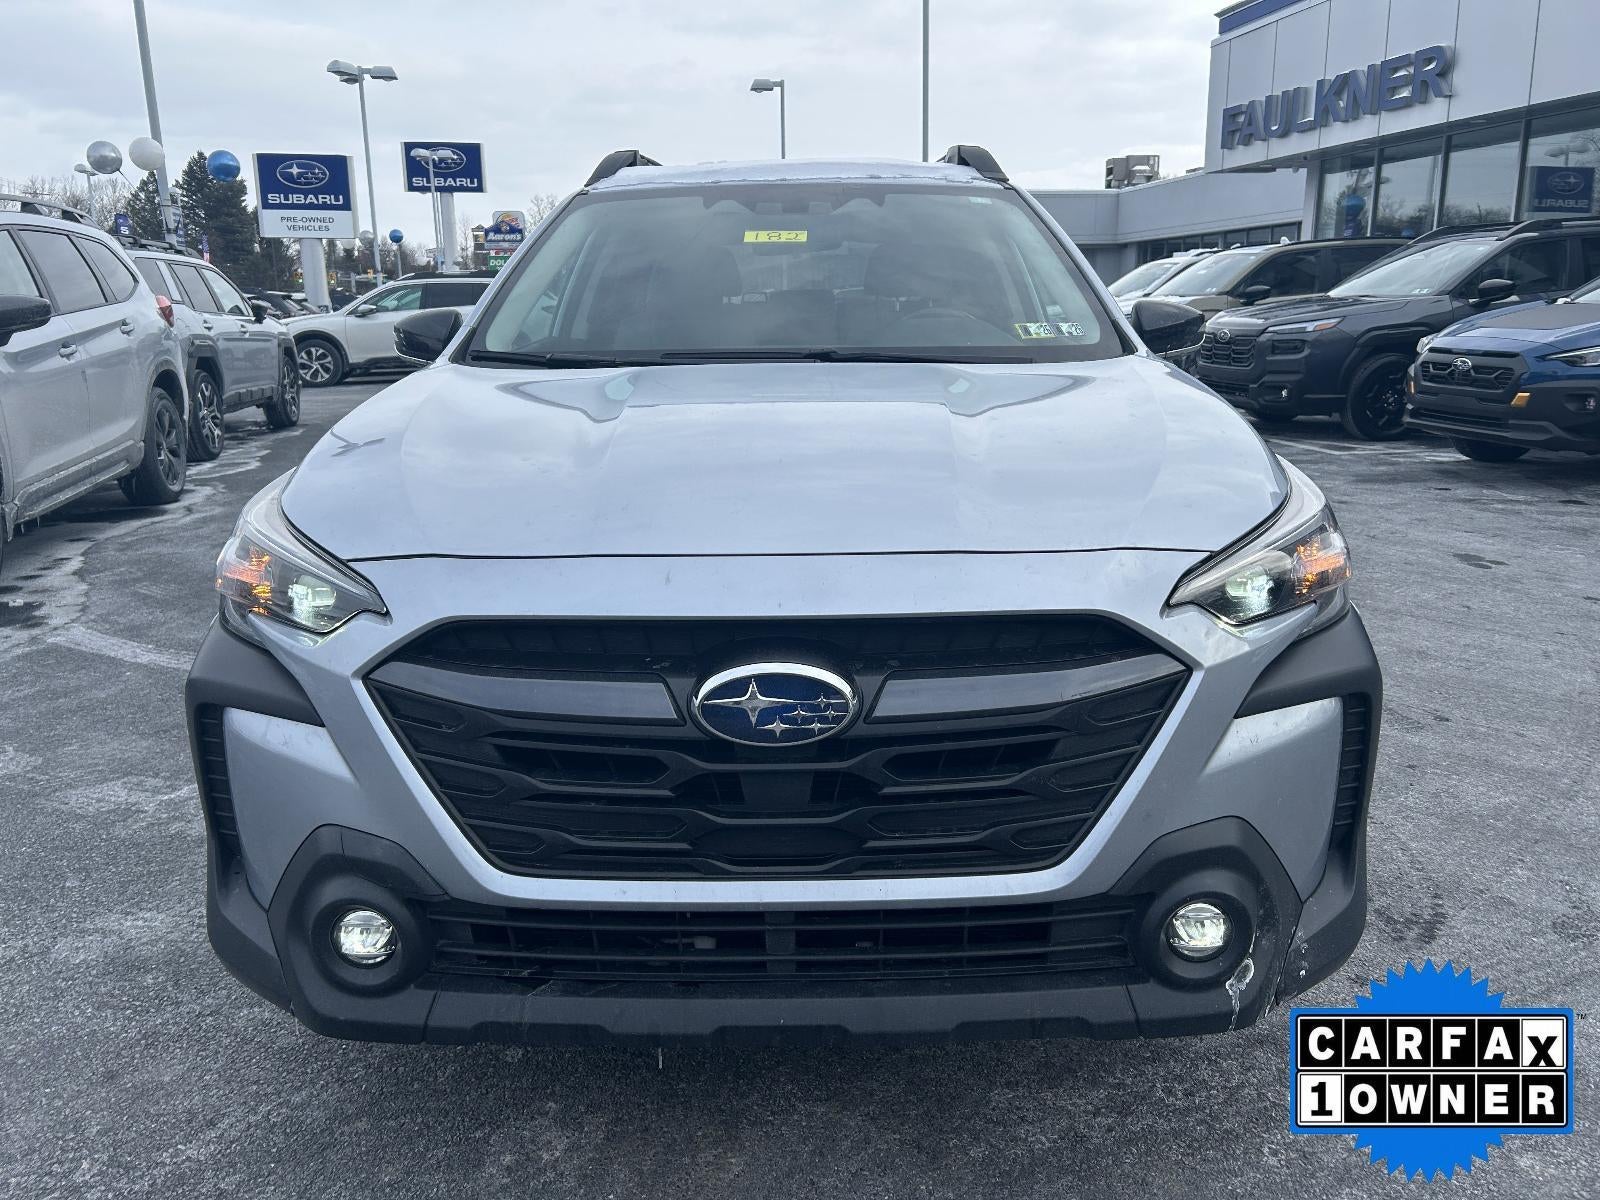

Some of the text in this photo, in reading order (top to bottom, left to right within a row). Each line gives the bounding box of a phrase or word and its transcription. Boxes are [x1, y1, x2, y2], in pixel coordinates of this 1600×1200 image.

[1220, 45, 1453, 150] FAULKNER
[267, 193, 344, 205] SUBARU
[280, 216, 335, 224] PRE-OWNED
[286, 224, 330, 232] VEHICLES
[755, 231, 802, 241] 182
